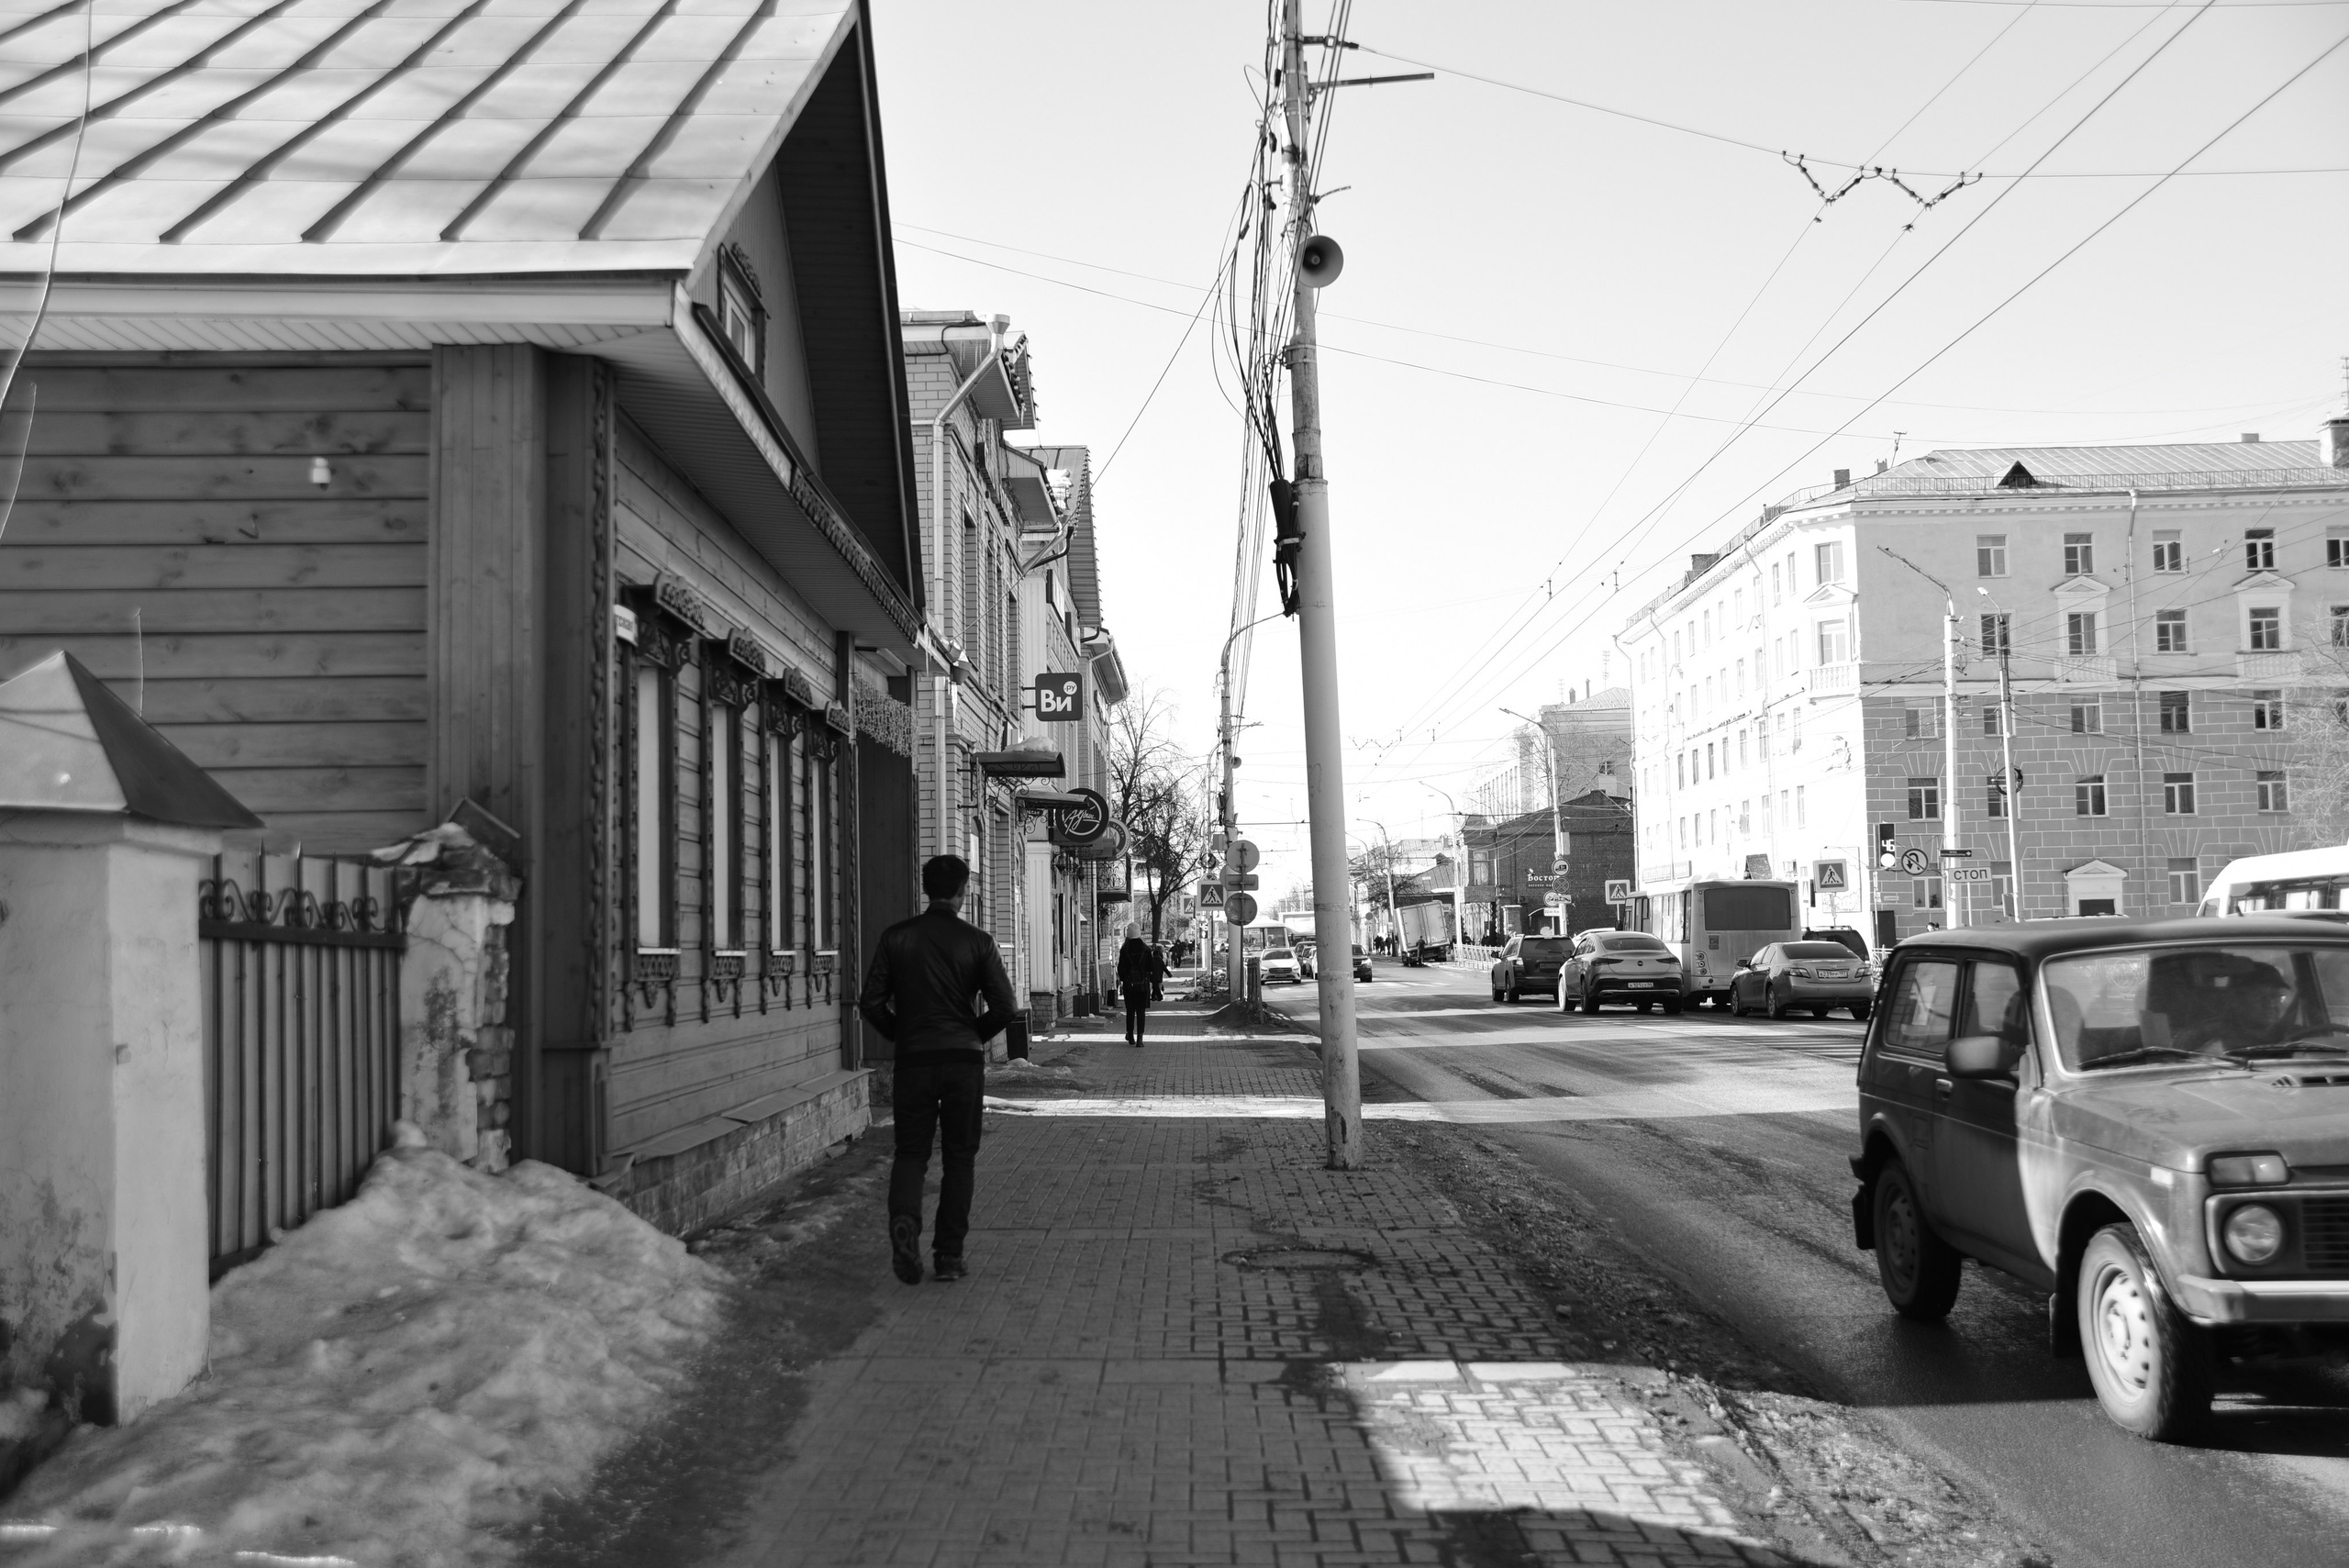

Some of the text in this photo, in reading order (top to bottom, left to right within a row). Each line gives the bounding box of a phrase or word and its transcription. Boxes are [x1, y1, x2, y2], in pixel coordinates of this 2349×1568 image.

[1041, 689, 1072, 712] Ви
[1881, 839, 1896, 852] 46
[1954, 869, 1987, 880] СТОП
